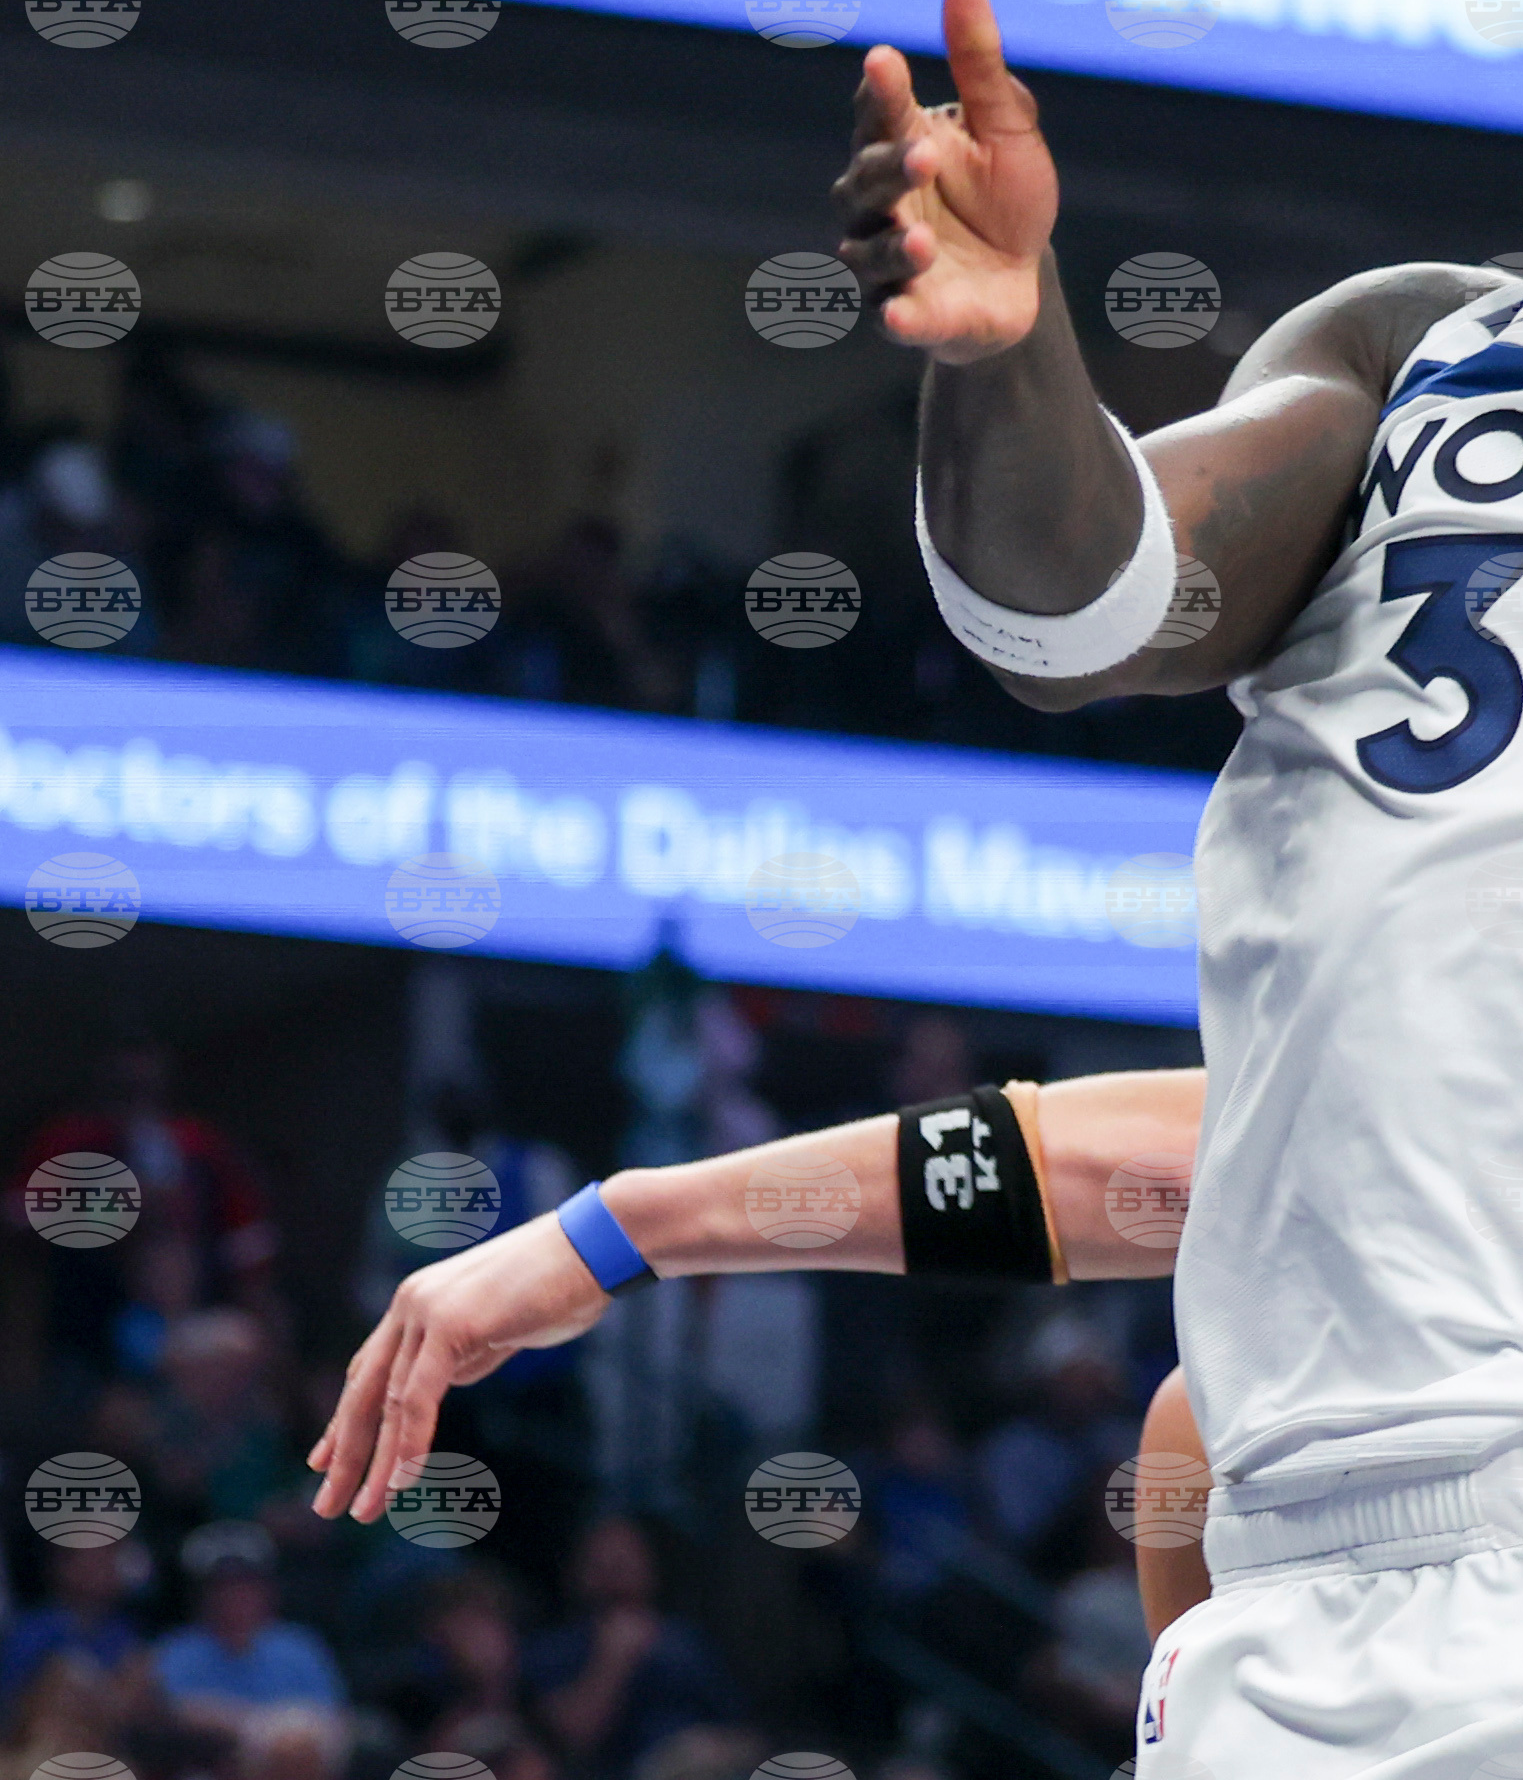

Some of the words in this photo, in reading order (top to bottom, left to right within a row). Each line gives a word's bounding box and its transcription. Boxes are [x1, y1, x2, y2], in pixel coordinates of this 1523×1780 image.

[0, 730, 318, 858] octors
[325, 761, 436, 866] of
[446, 769, 606, 888] the
[919, 1107, 974, 1212] 31
[972, 1115, 1001, 1192] KT
